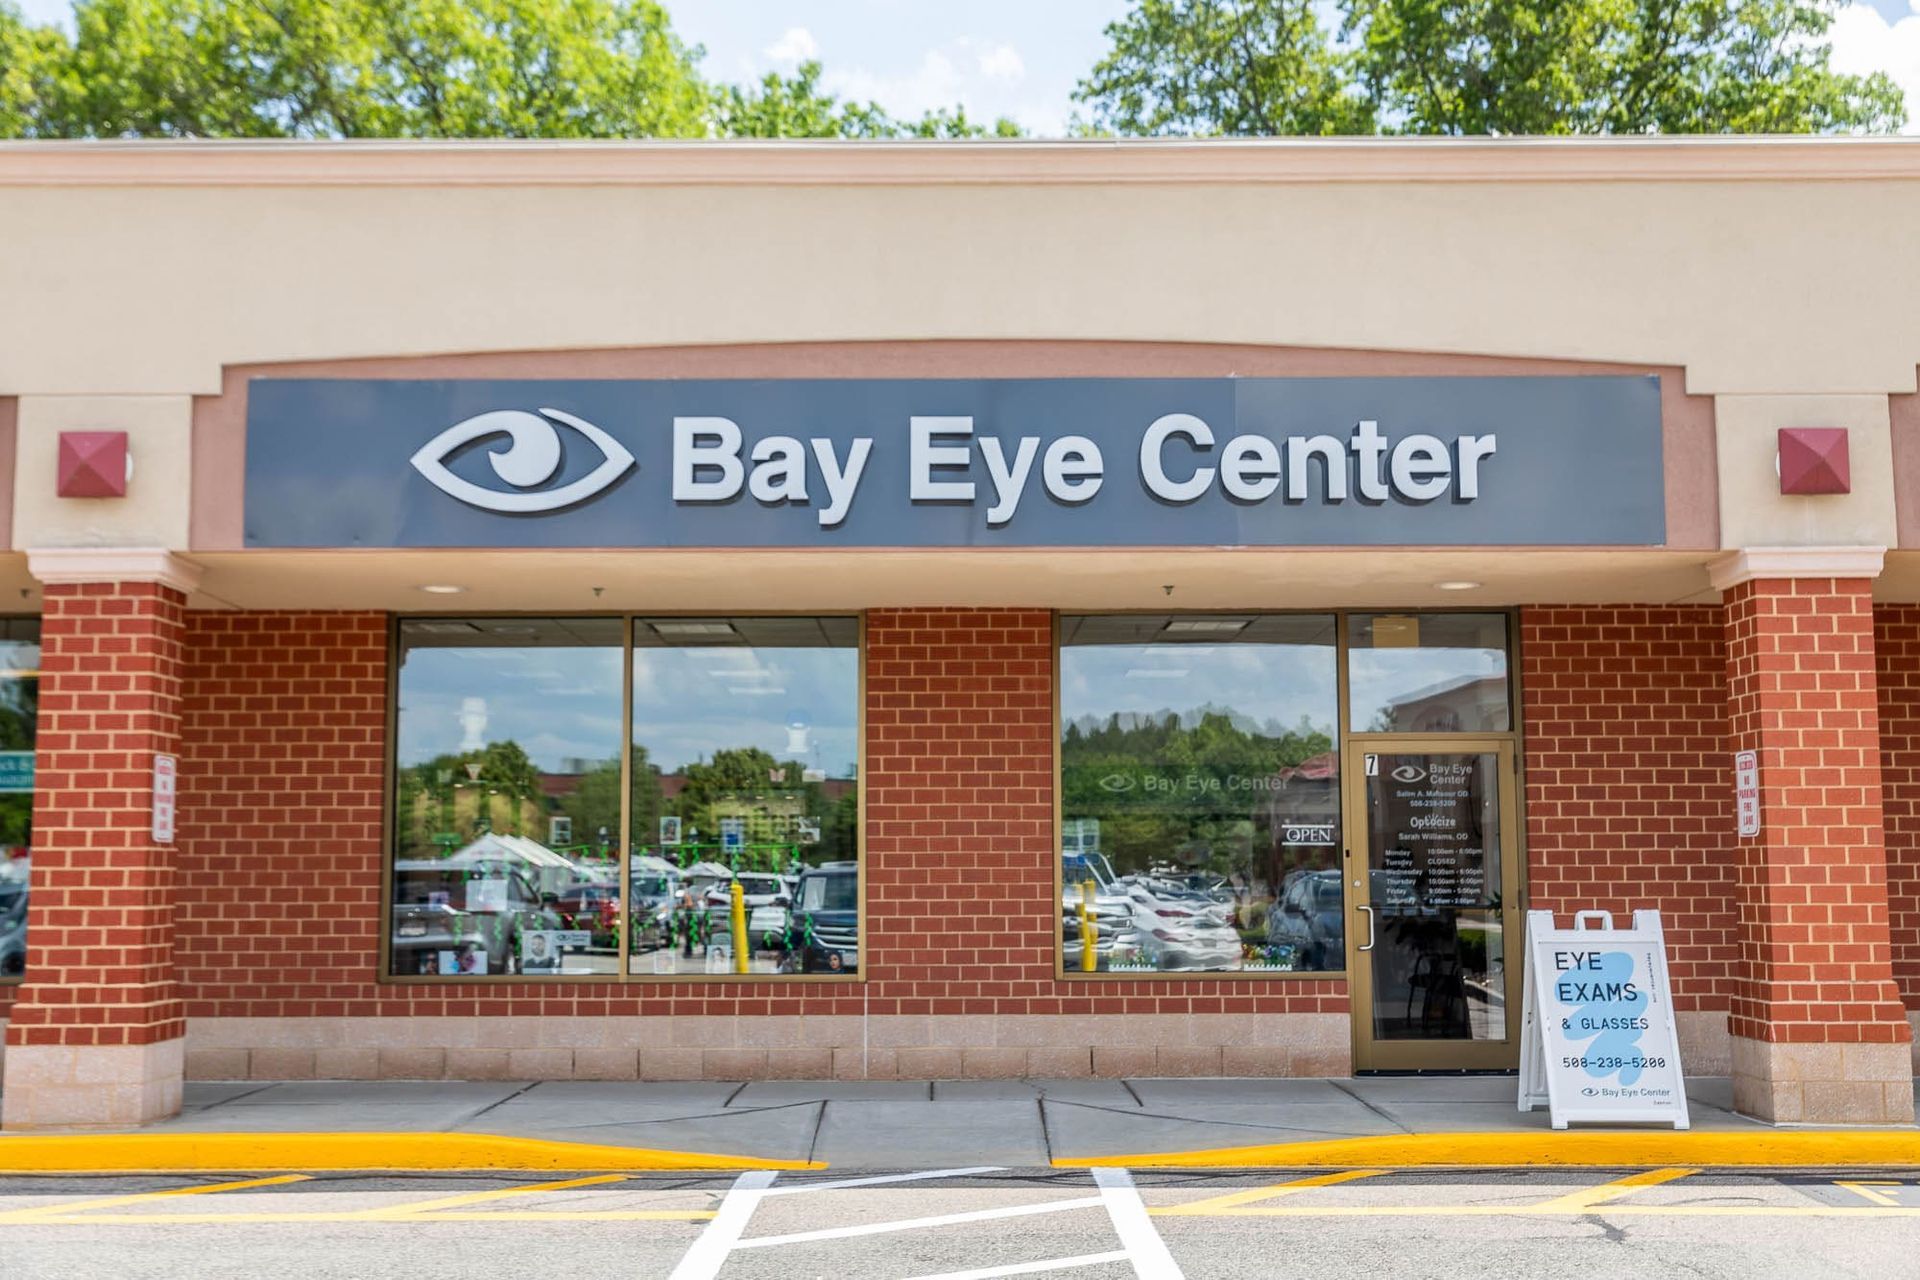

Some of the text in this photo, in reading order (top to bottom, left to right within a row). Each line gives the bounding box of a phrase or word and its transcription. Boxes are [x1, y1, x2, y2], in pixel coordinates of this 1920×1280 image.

[673, 413, 1497, 525] Bay Eye Center
[1366, 756, 1376, 774] 7
[1429, 763, 1472, 776] Bay Eye
[1143, 775, 1288, 794] Bay Eye Center
[1430, 775, 1466, 784] Center
[1286, 829, 1331, 842] OPEN
[1385, 849, 1411, 857] Monday
[1386, 859, 1413, 867] Tuesday
[1555, 952, 1604, 971] EYE
[1558, 982, 1639, 1002] EXAMS
[1561, 1018, 1649, 1030] & GLASSES
[1562, 1056, 1666, 1069] 508-238-5200
[1602, 1088, 1671, 1098] Bay Eye Center
